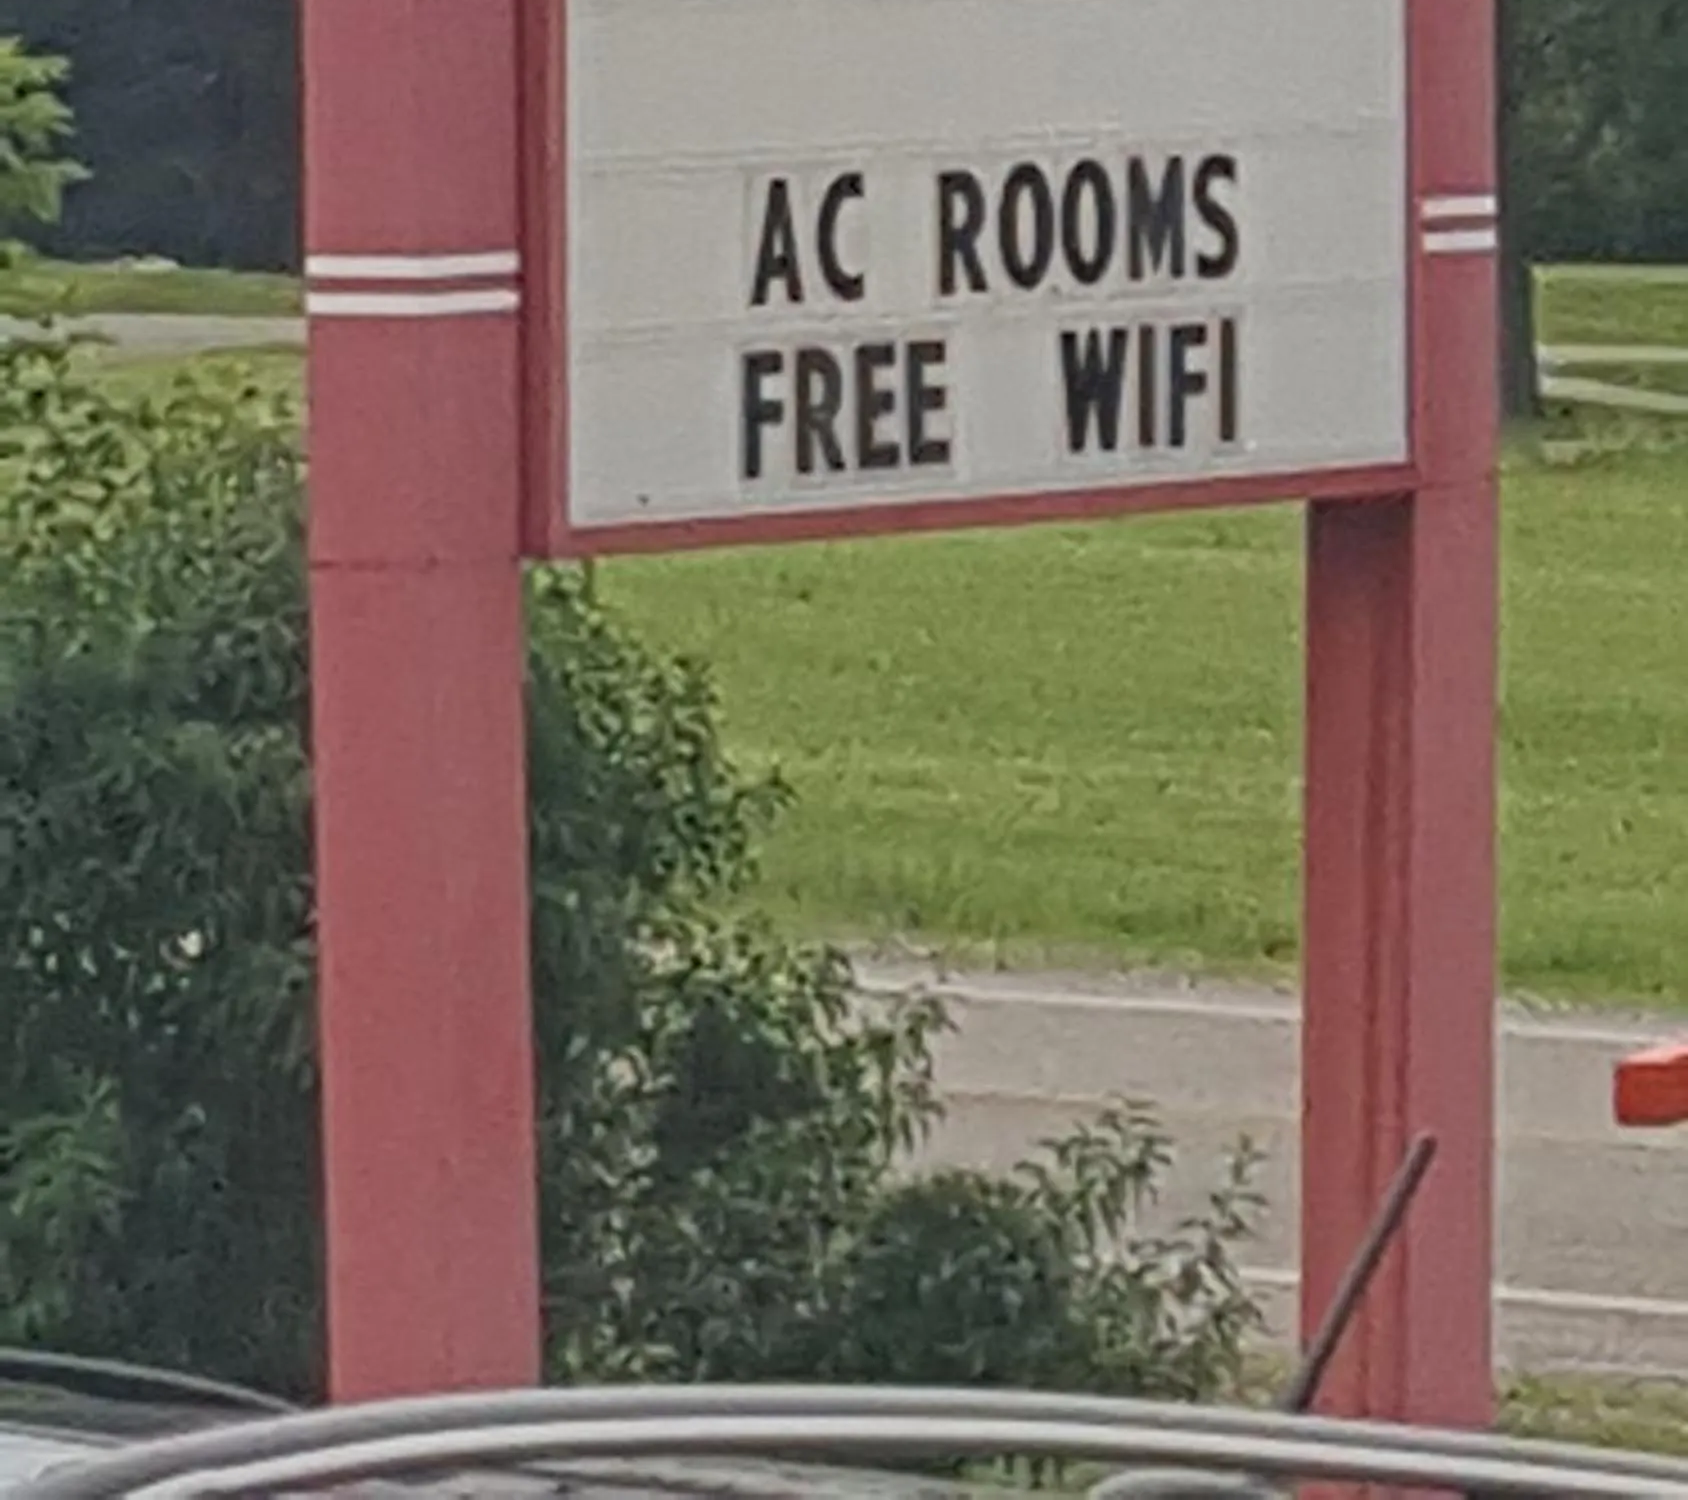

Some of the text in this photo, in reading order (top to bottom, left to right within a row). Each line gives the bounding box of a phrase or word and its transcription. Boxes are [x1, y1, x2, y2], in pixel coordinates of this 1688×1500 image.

[749, 155, 1240, 307] AC ROOMS
[740, 317, 1238, 479] FREE WIFI
